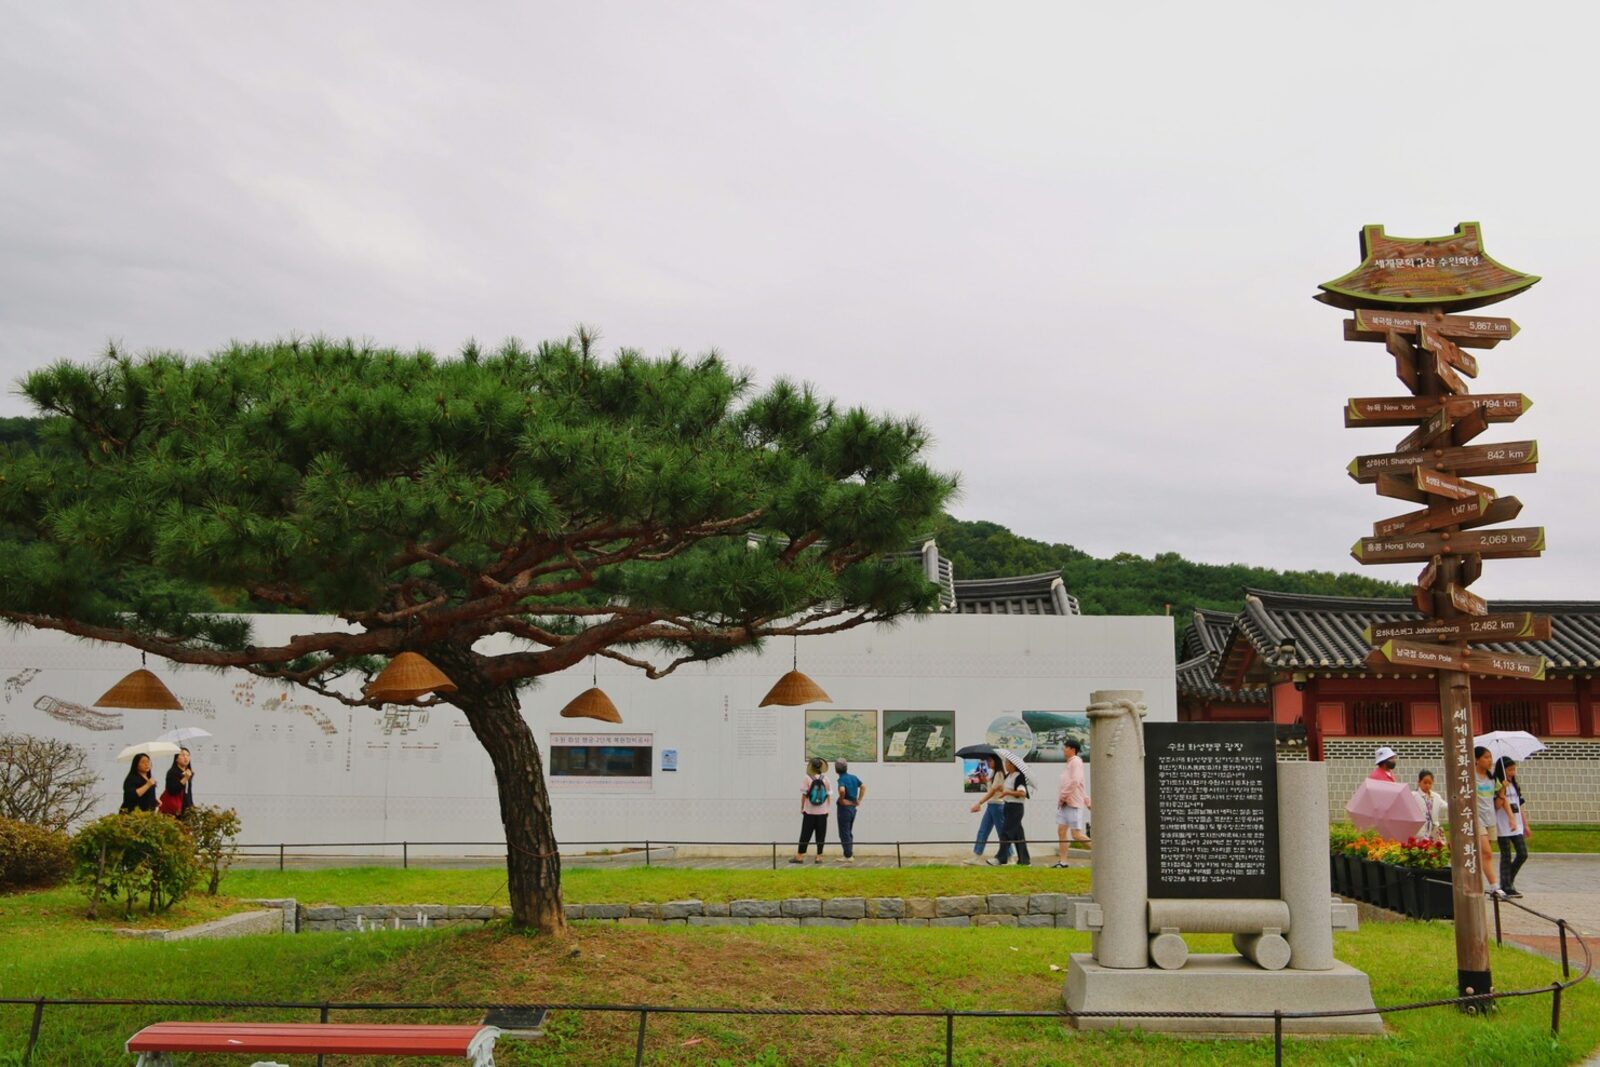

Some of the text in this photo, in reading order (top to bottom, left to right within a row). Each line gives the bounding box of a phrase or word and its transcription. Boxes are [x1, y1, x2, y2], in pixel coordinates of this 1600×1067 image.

[1394, 318, 1412, 328] North
[1494, 323, 1507, 332] km
[1401, 403, 1417, 411] York
[1503, 399, 1518, 408] km
[1365, 450, 1525, 469] 상하이 Shanghai 842 km
[1384, 543, 1404, 551] Hong
[1406, 541, 1425, 550] Kong
[1511, 534, 1527, 544] km
[1415, 624, 1460, 635] Johannesburg
[1470, 620, 1498, 632] 12,462
[1500, 619, 1515, 629] km
[1418, 650, 1437, 661] South
[1438, 653, 1453, 663] Pole
[1517, 662, 1531, 673] km
[1168, 743, 1185, 752] 수원
[1453, 707, 1477, 875] 세계문화유산 수원 화성
